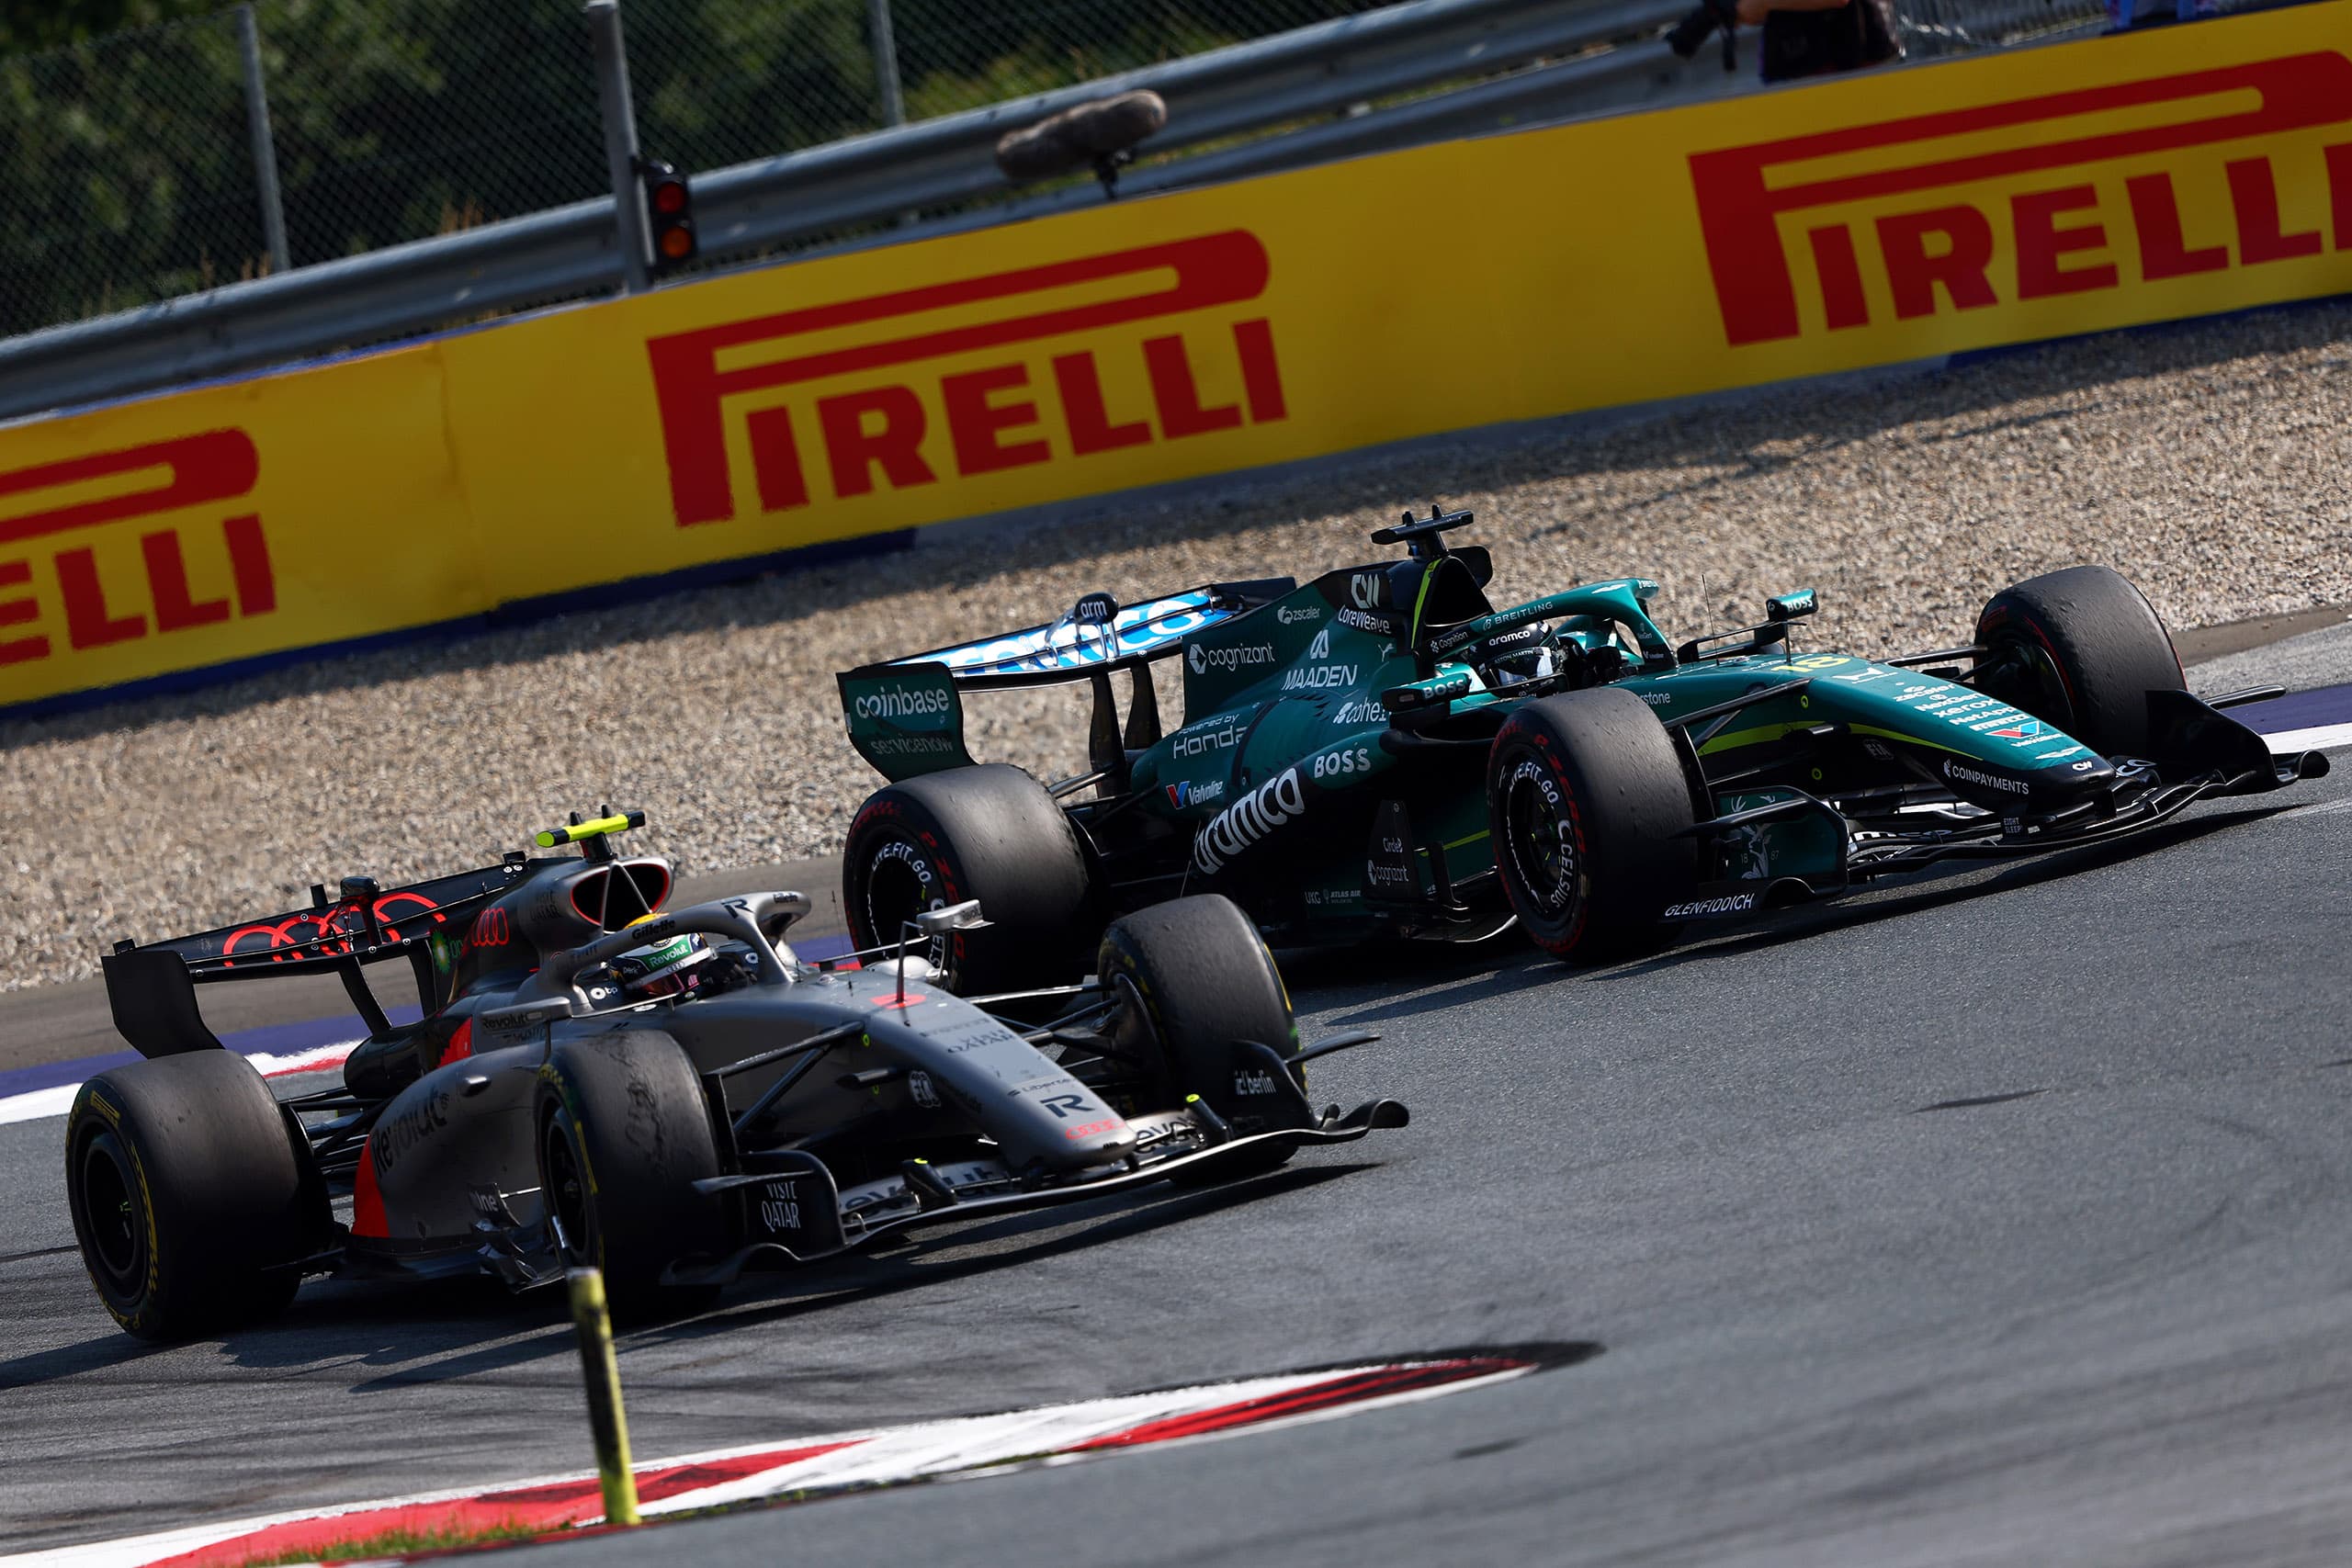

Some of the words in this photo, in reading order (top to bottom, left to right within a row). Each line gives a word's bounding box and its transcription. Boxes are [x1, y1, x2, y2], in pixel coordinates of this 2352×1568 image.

[646, 228, 1288, 527] PIRELLI
[1080, 599, 1107, 618] arm
[1293, 605, 1320, 621] zscaler
[1494, 601, 1554, 625] BREITLING
[1786, 597, 1814, 613] BOSS
[1338, 604, 1392, 635] CoreWeave
[1438, 630, 1469, 649] Cognition
[1488, 630, 1532, 647] aramco
[1207, 642, 1276, 672] cognizant
[1280, 664, 1359, 692] MAADEN
[1421, 678, 1467, 700] BOSS
[854, 683, 950, 719] coinbase
[1932, 698, 2005, 719] xerox
[1949, 705, 2018, 726] NetApp
[870, 732, 954, 756] servicenow
[1313, 748, 1372, 779] BOSS
[1951, 766, 2030, 795] COINPAYMENTS
[1188, 781, 1224, 807] Valvoline
[1193, 768, 1306, 874] aramco
[1550, 842, 1574, 908] CELSIUS
[1664, 892, 1756, 918] GLENFIDDICH
[631, 919, 675, 940] Gillette
[649, 943, 688, 967] Revolut
[604, 986, 618, 998] bp
[1245, 1069, 1277, 1096] berlin
[1039, 1094, 1095, 1119] R
[766, 1179, 798, 1201] VISIT
[761, 1198, 802, 1234] QATAR
